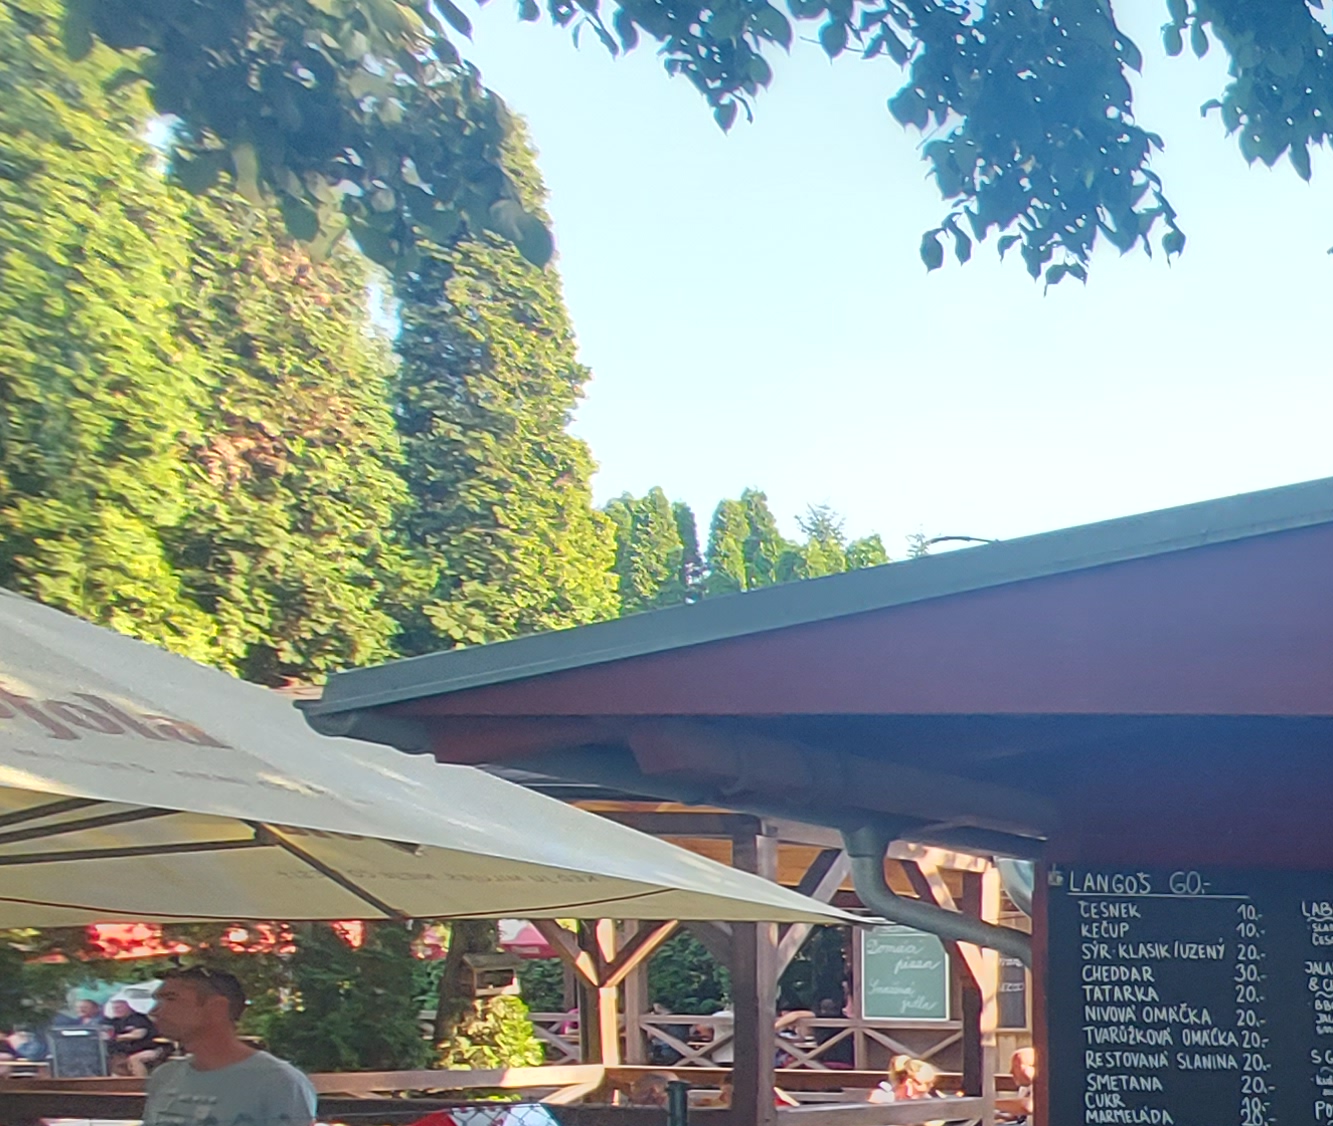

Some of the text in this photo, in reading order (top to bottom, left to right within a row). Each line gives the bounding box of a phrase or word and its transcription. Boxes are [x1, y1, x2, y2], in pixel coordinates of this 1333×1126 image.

[1069, 870, 1151, 894] LANGOŠ
[1078, 900, 1141, 918] ČESNEK
[1081, 920, 1130, 938] KEČUP
[1082, 964, 1155, 982] CHEDDAR
[1082, 985, 1159, 1002] TATARKA
[1084, 1004, 1136, 1023] NIVOVÁ
[1142, 1002, 1212, 1025] OMÁČKA
[1083, 1025, 1173, 1046] TVARŮŽKOVÁ
[1182, 1027, 1239, 1047] OMÁČKA
[1085, 1050, 1169, 1069] RESTOVANÁ
[1176, 1052, 1239, 1071] SLANINA
[1311, 1050, 1321, 1063] S
[1087, 1073, 1163, 1092] SMETANA
[1085, 1091, 1126, 1108] CUKR
[1086, 1106, 1174, 1125] MARMELÁDA
